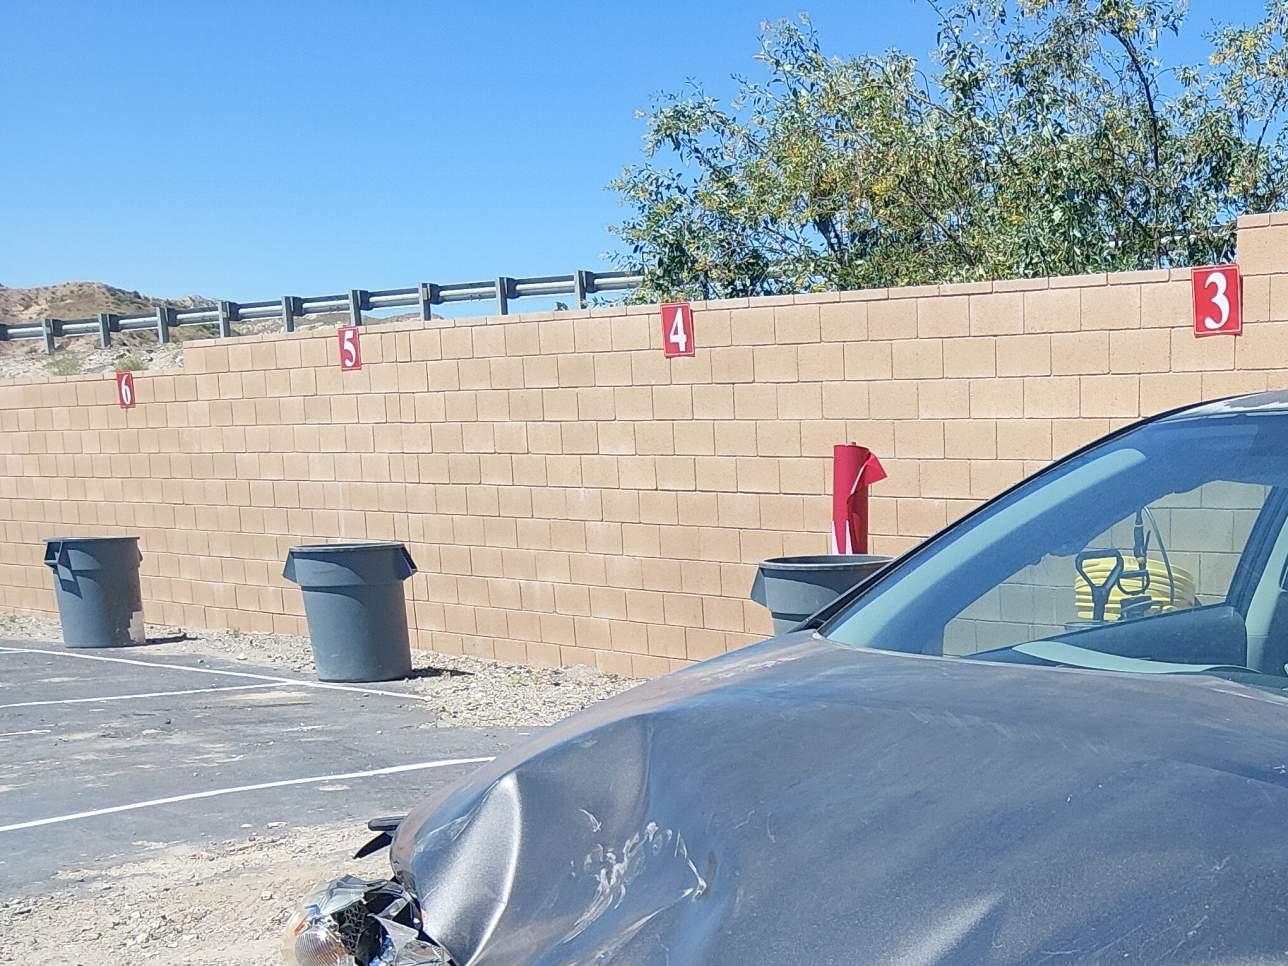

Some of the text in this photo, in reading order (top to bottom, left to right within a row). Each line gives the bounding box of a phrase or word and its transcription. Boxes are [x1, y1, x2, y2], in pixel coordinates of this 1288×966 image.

[1204, 271, 1230, 330] 3
[343, 329, 356, 367] 5
[669, 307, 687, 352] 4
[121, 374, 132, 405] 6
